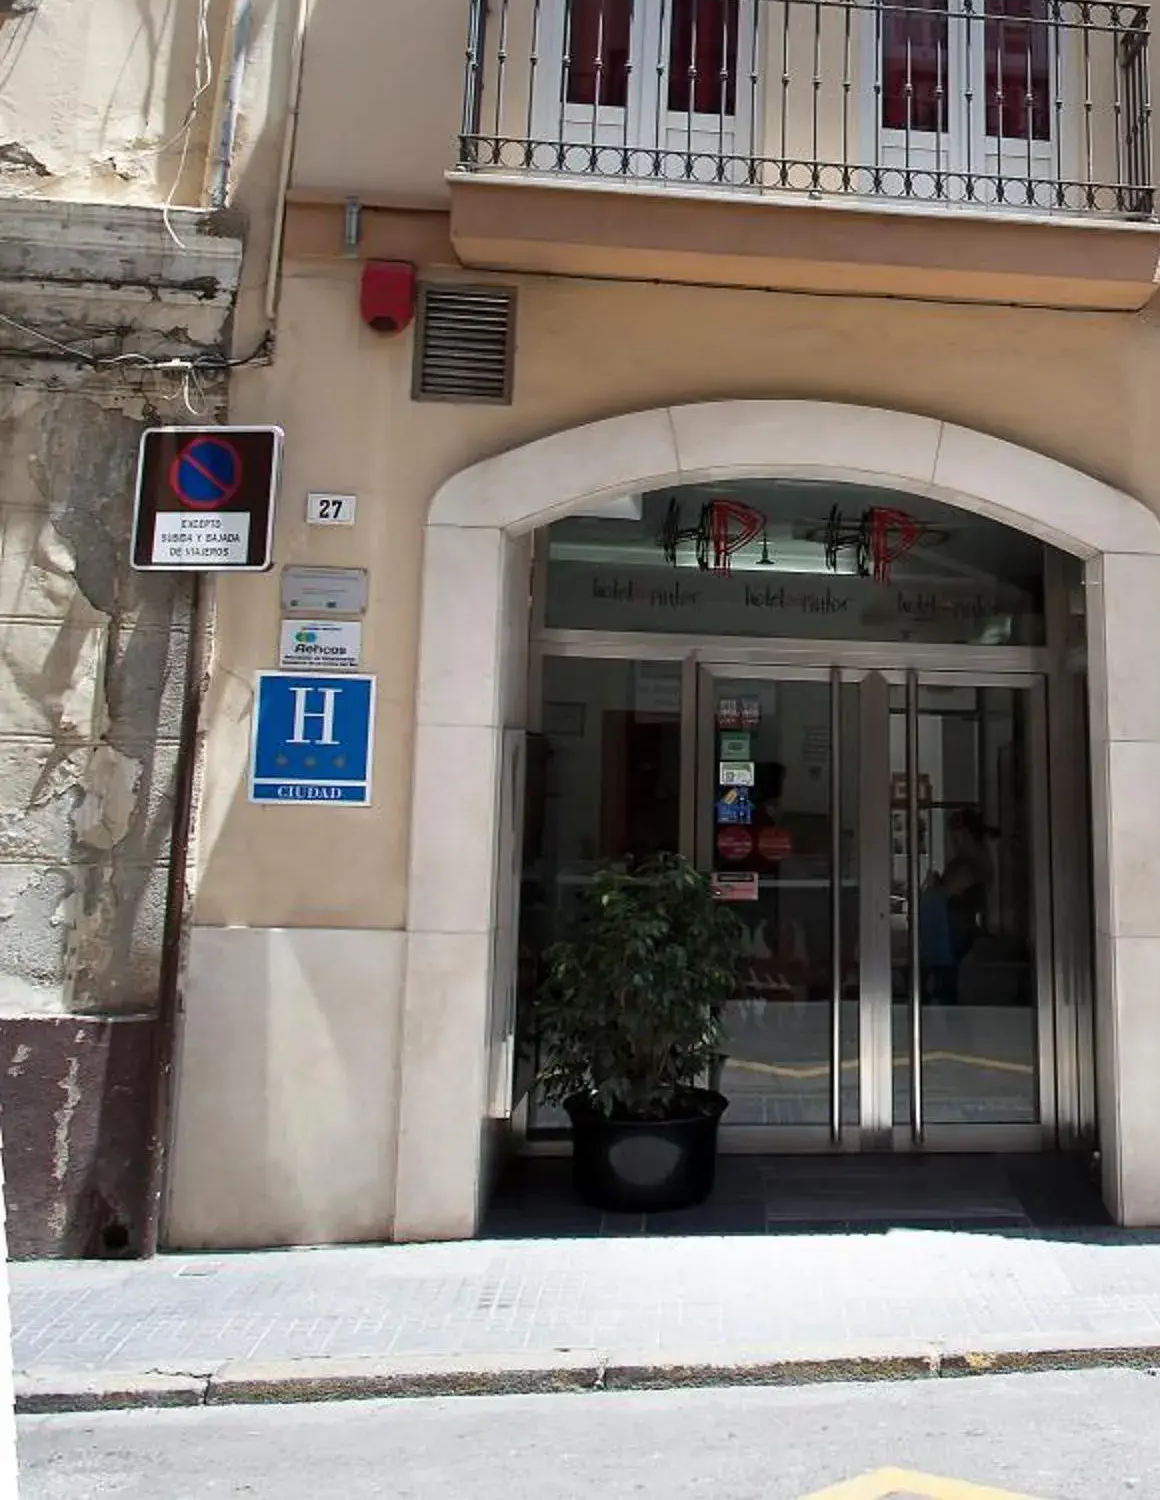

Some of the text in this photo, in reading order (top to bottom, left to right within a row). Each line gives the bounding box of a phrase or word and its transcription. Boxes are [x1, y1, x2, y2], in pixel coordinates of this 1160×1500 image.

[319, 499, 342, 518] 27
[181, 519, 222, 529] EXCEPTO
[161, 533, 241, 543] SUBIDA Y BAJADA
[169, 547, 230, 557] DE VIAJEROS
[294, 643, 347, 655] Aehcos
[285, 686, 343, 745] H
[277, 786, 342, 799] CIUDAD
